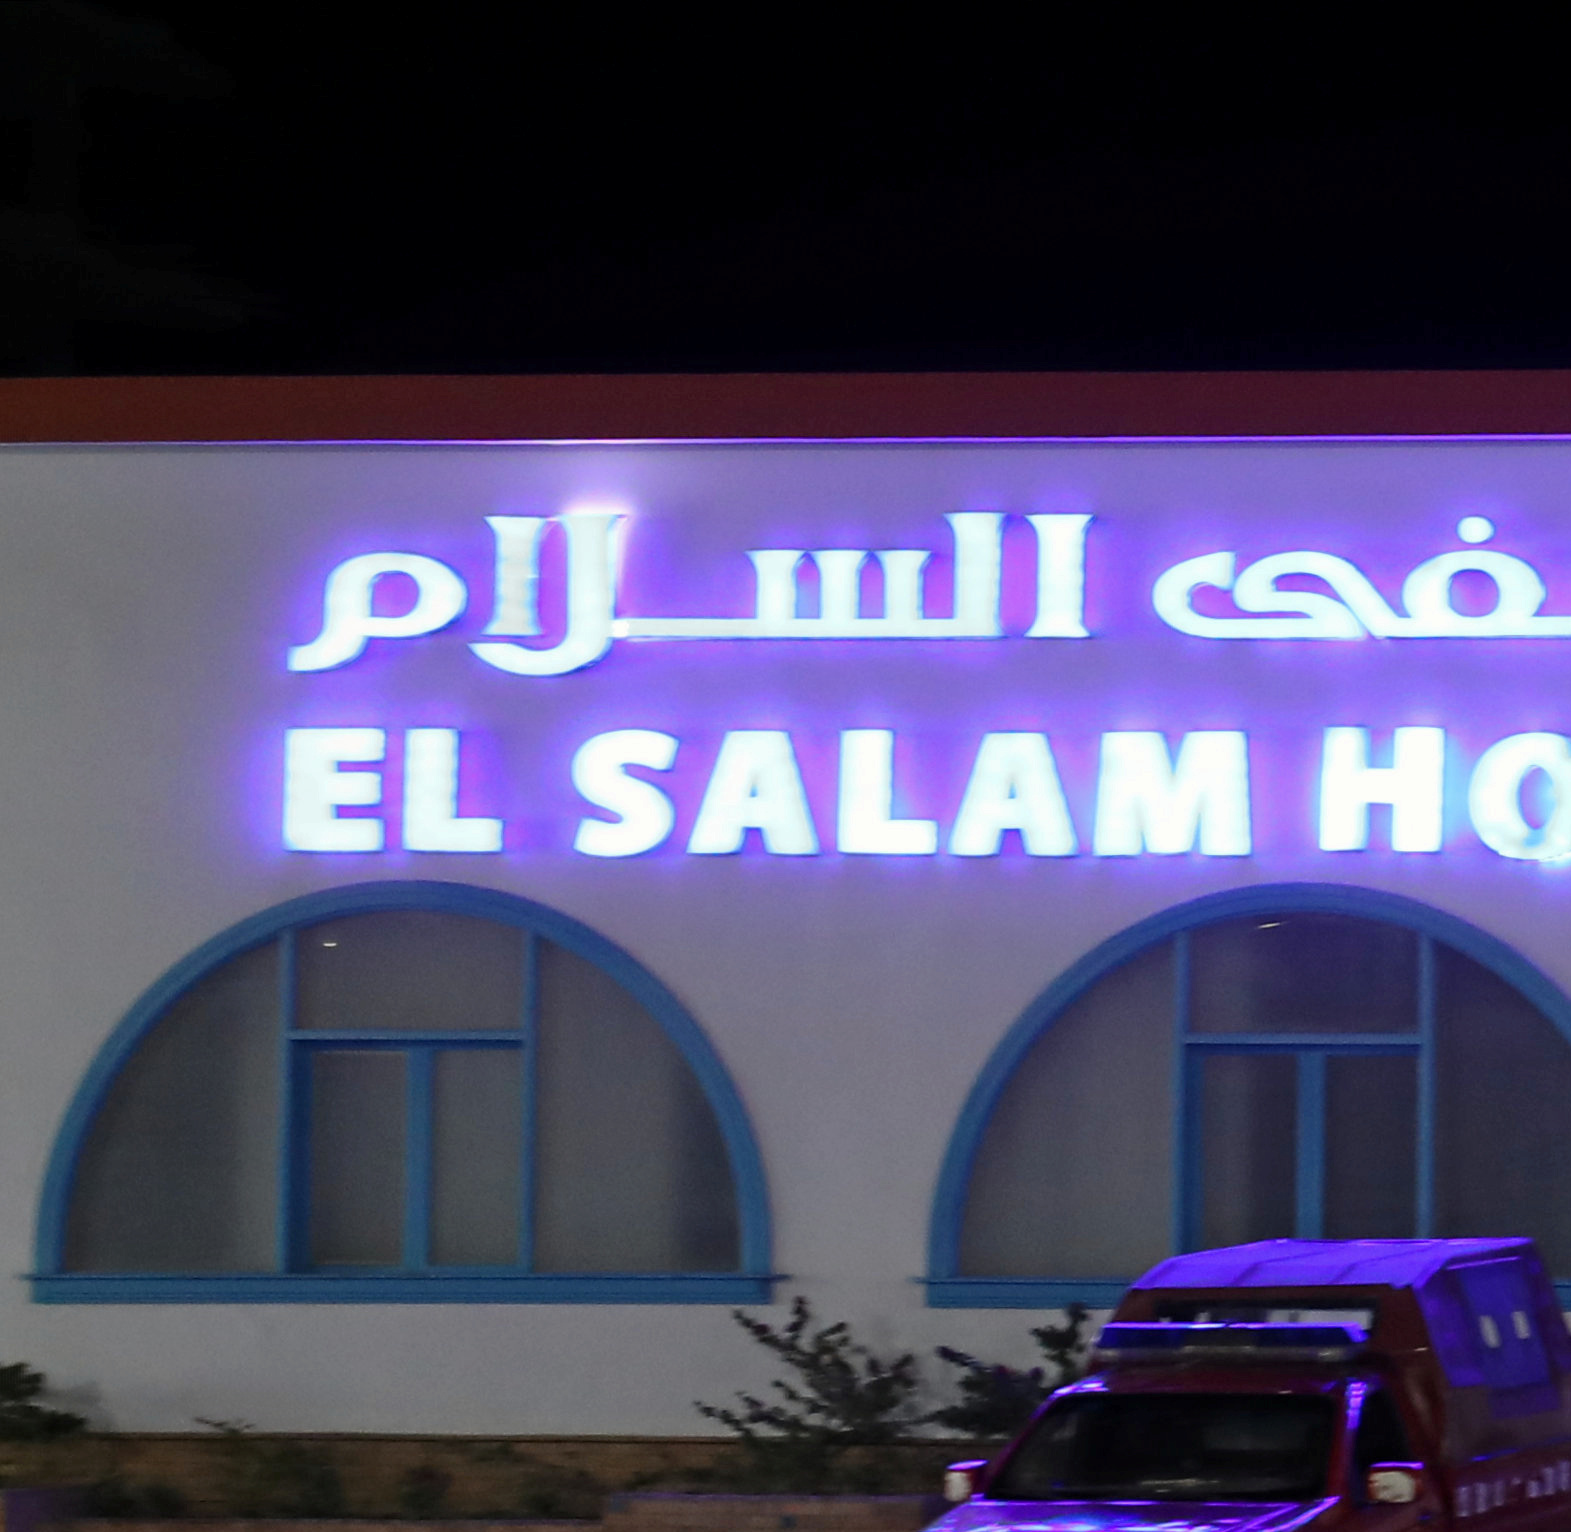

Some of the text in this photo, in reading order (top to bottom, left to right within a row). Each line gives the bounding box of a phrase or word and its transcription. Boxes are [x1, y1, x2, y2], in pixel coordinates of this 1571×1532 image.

[287, 511, 1094, 676] السلام
[283, 727, 503, 852] EL
[572, 729, 1252, 856] SALAM
